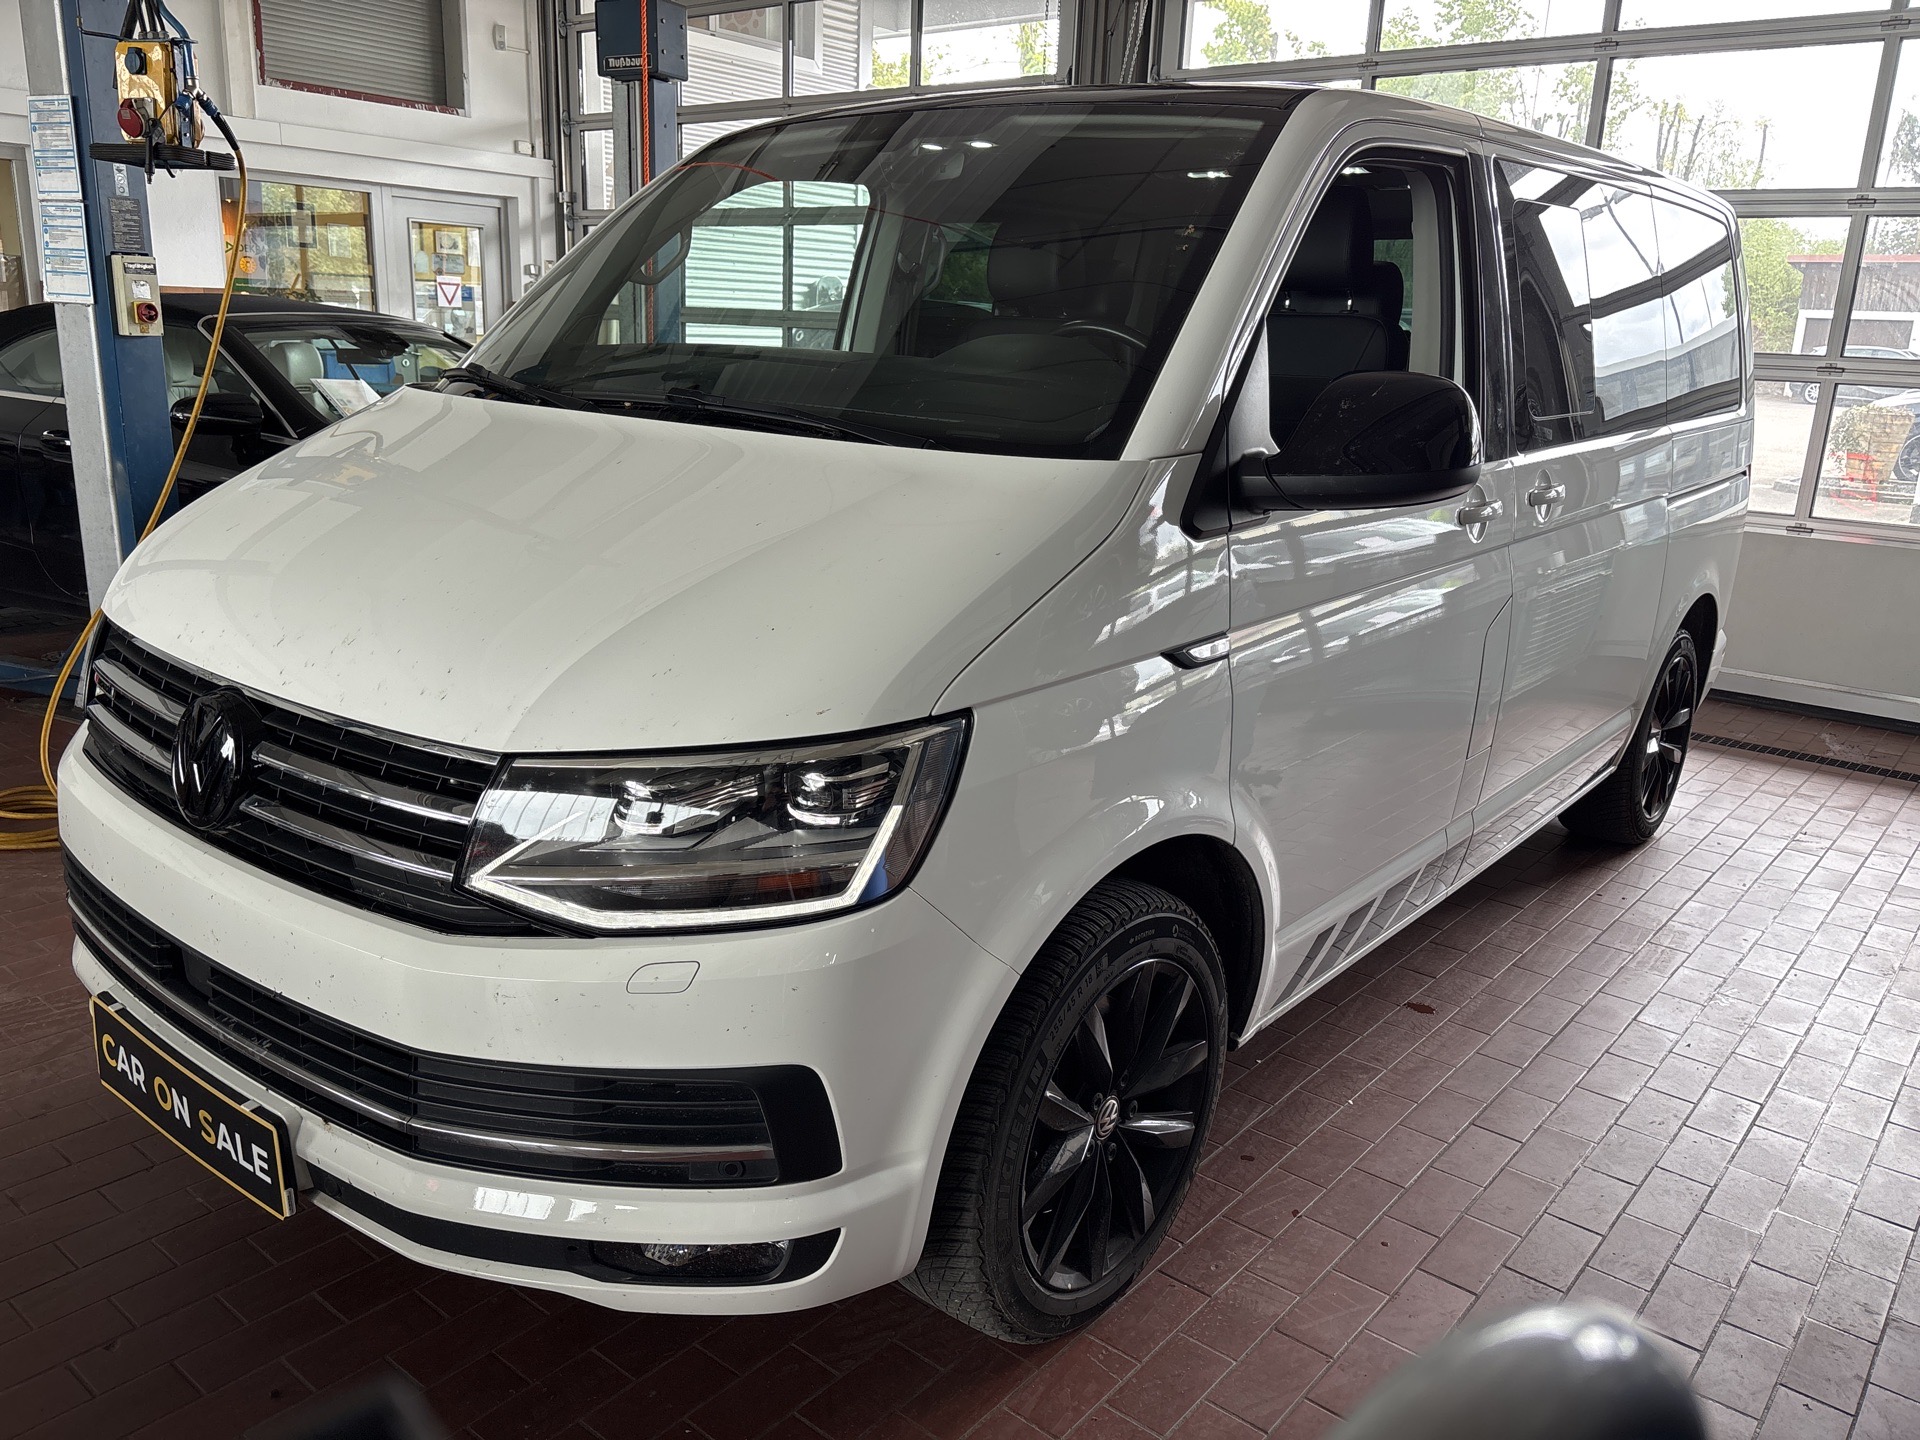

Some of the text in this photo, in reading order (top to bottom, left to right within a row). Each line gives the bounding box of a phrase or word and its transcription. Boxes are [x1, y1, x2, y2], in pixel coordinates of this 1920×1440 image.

[608, 57, 646, 67] Nußbau
[102, 1033, 273, 1185] CAR ON SALE
